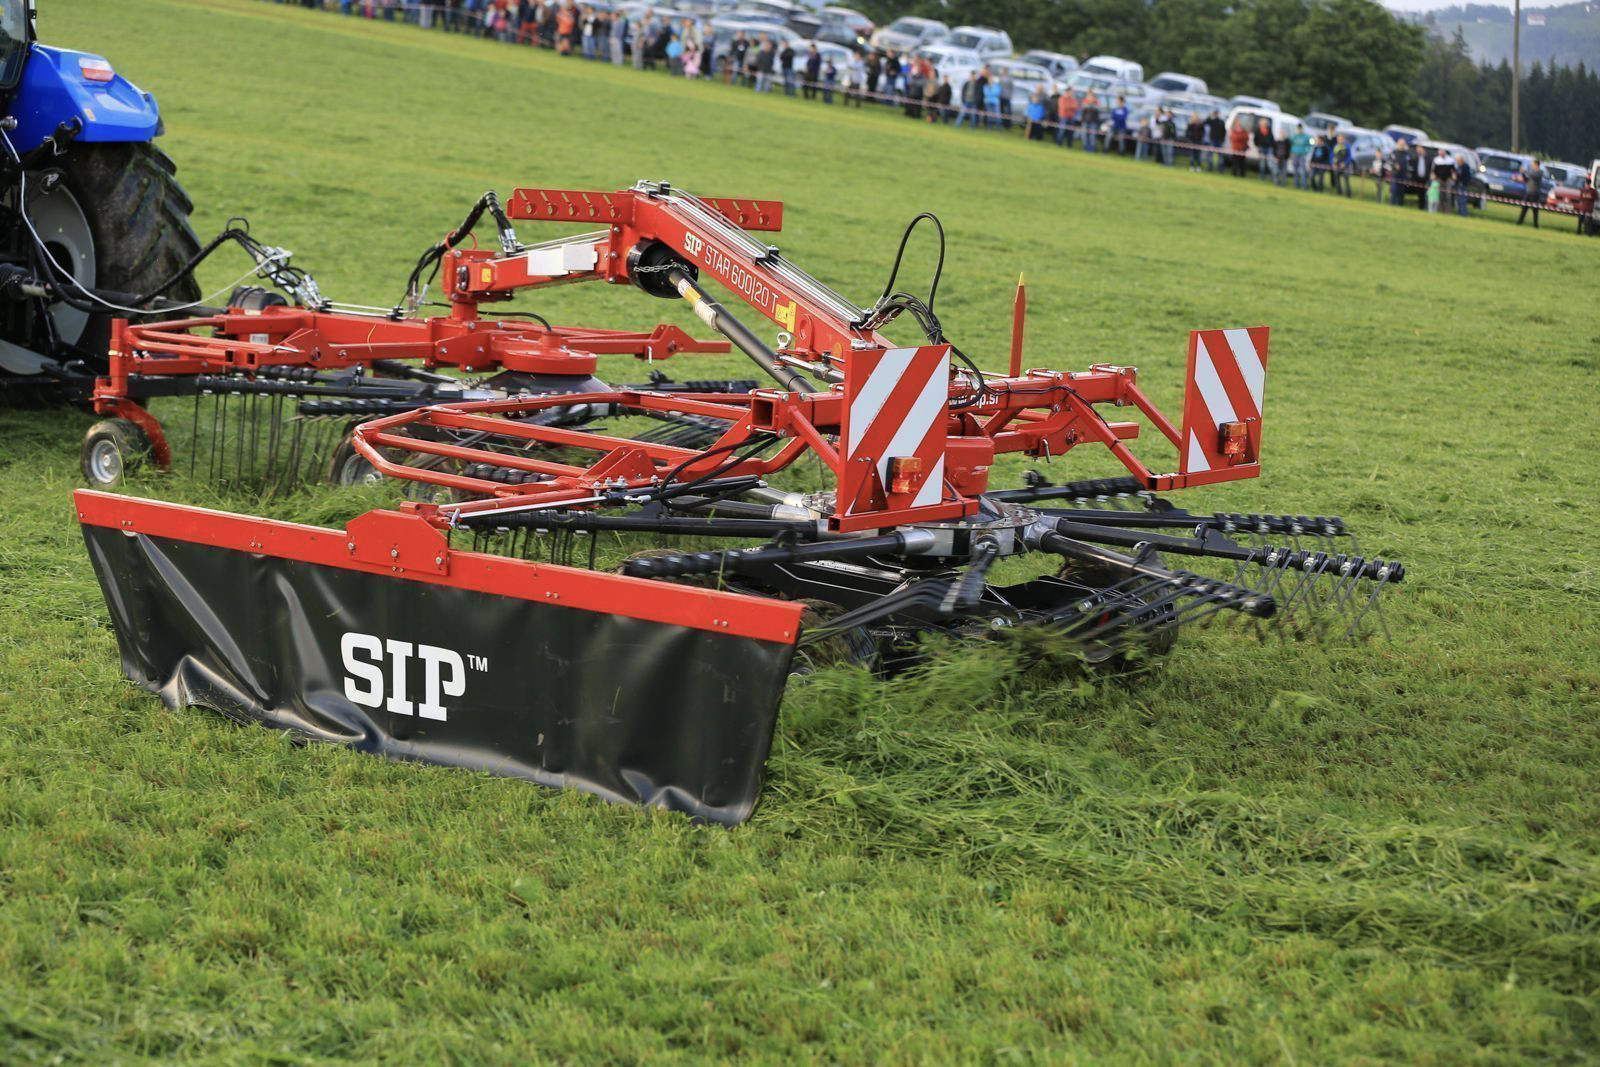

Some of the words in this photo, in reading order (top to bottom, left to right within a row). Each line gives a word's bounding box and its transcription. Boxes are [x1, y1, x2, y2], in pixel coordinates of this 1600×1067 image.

[684, 231, 702, 257] SIP
[704, 245, 731, 279] STAR
[731, 264, 770, 308] 600|20
[771, 292, 779, 314] T
[341, 632, 466, 722] SIP
